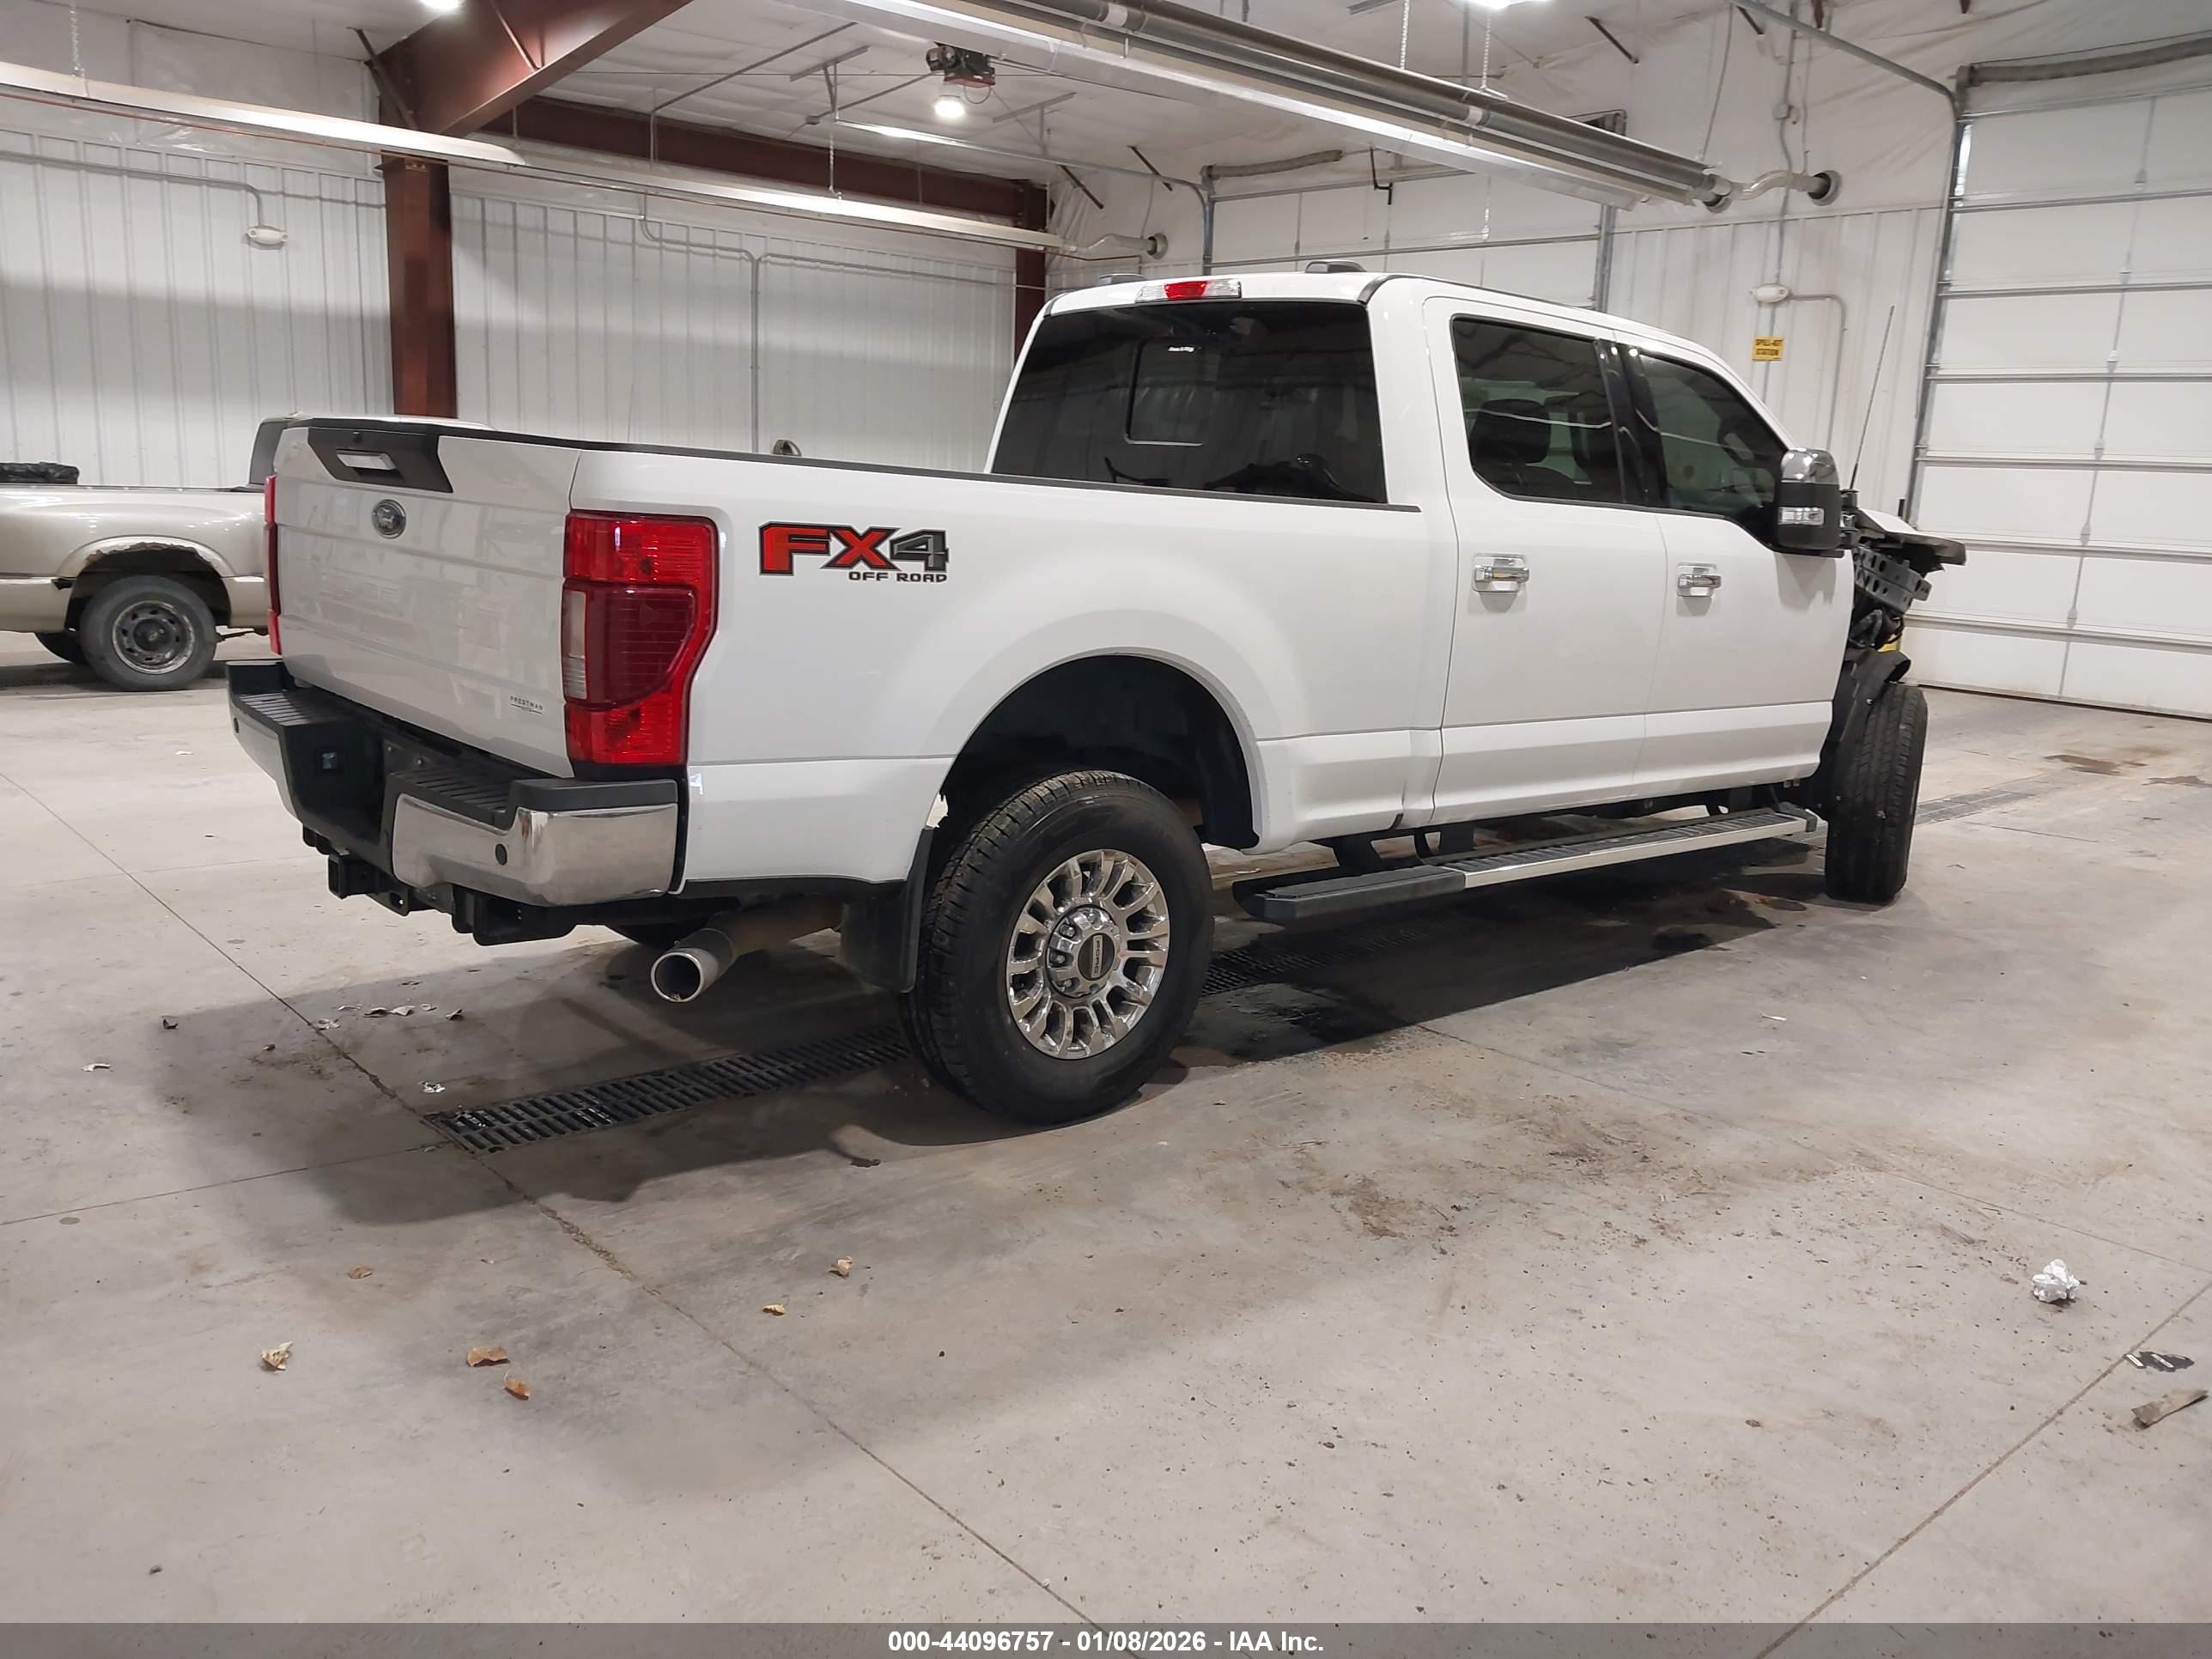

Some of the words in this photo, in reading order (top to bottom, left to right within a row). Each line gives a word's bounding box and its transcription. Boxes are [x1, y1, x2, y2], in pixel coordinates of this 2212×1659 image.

[758, 520, 950, 576] FX4
[848, 570, 889, 582] OFF
[896, 572, 948, 584] ROAD
